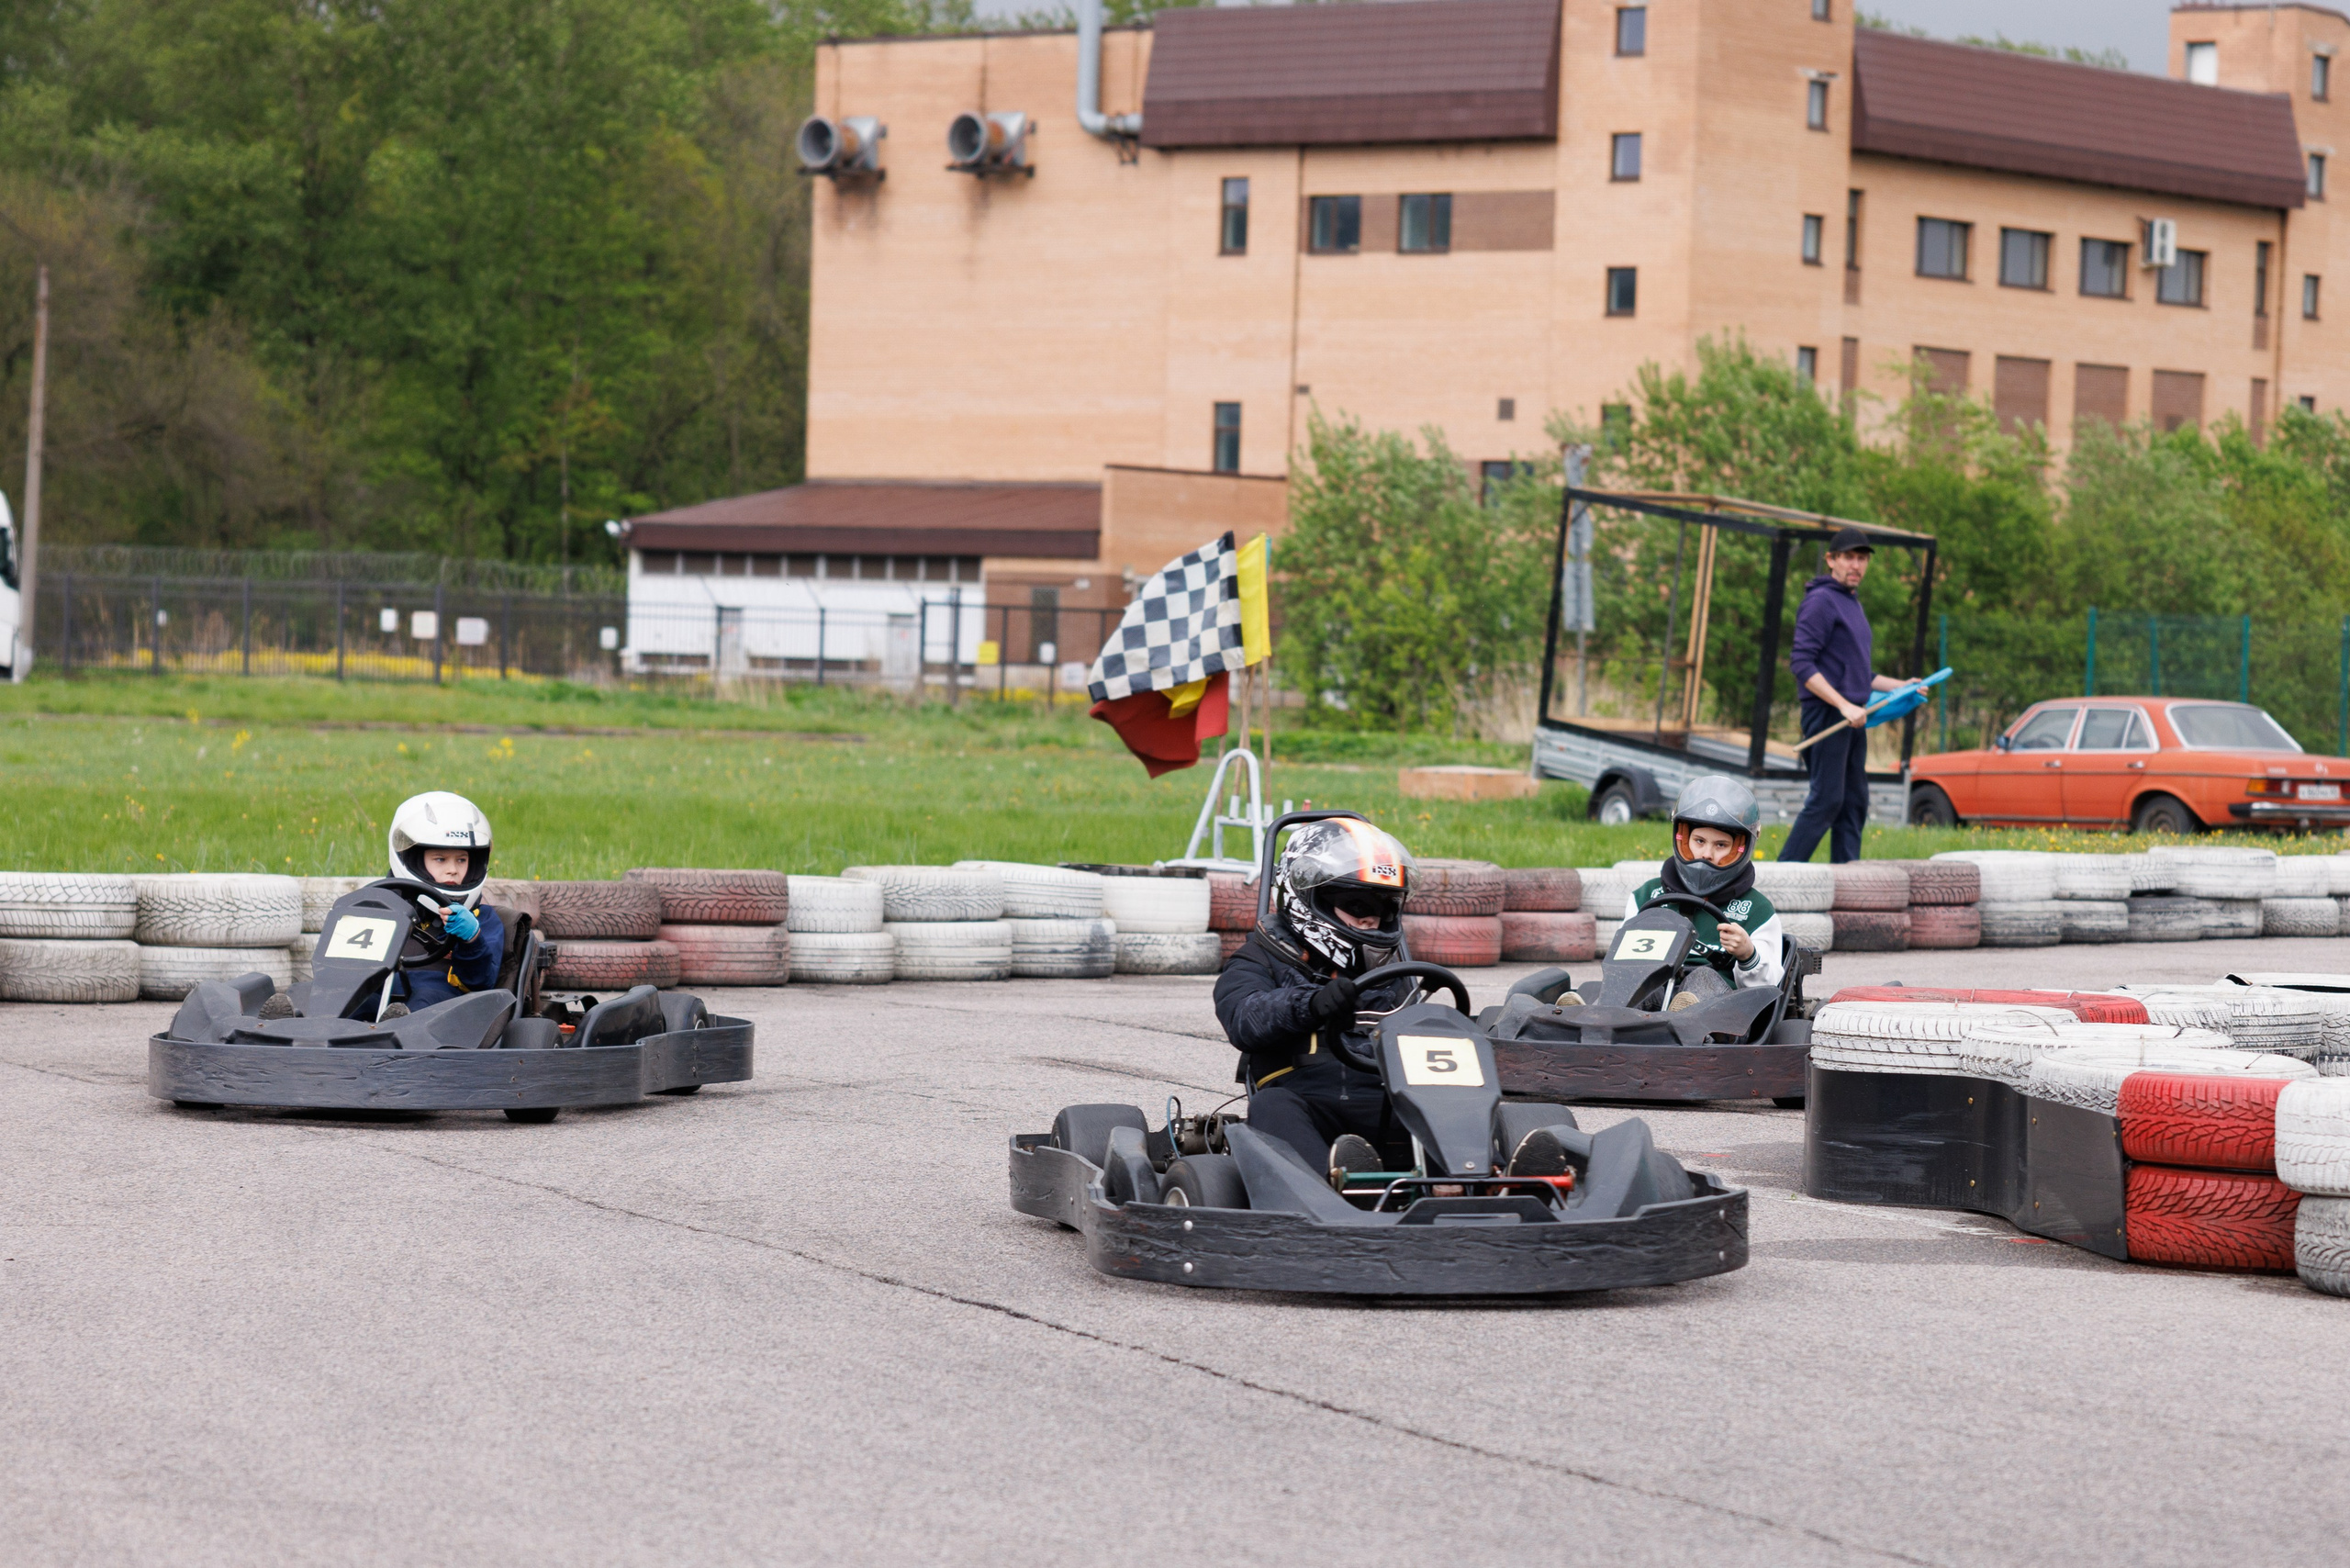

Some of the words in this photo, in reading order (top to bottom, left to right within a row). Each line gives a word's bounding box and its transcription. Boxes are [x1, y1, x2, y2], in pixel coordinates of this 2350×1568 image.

[1727, 899, 1752, 914] 88
[346, 928, 375, 949] 4
[1631, 938, 1656, 953] 3
[1426, 1049, 1458, 1073] 5
